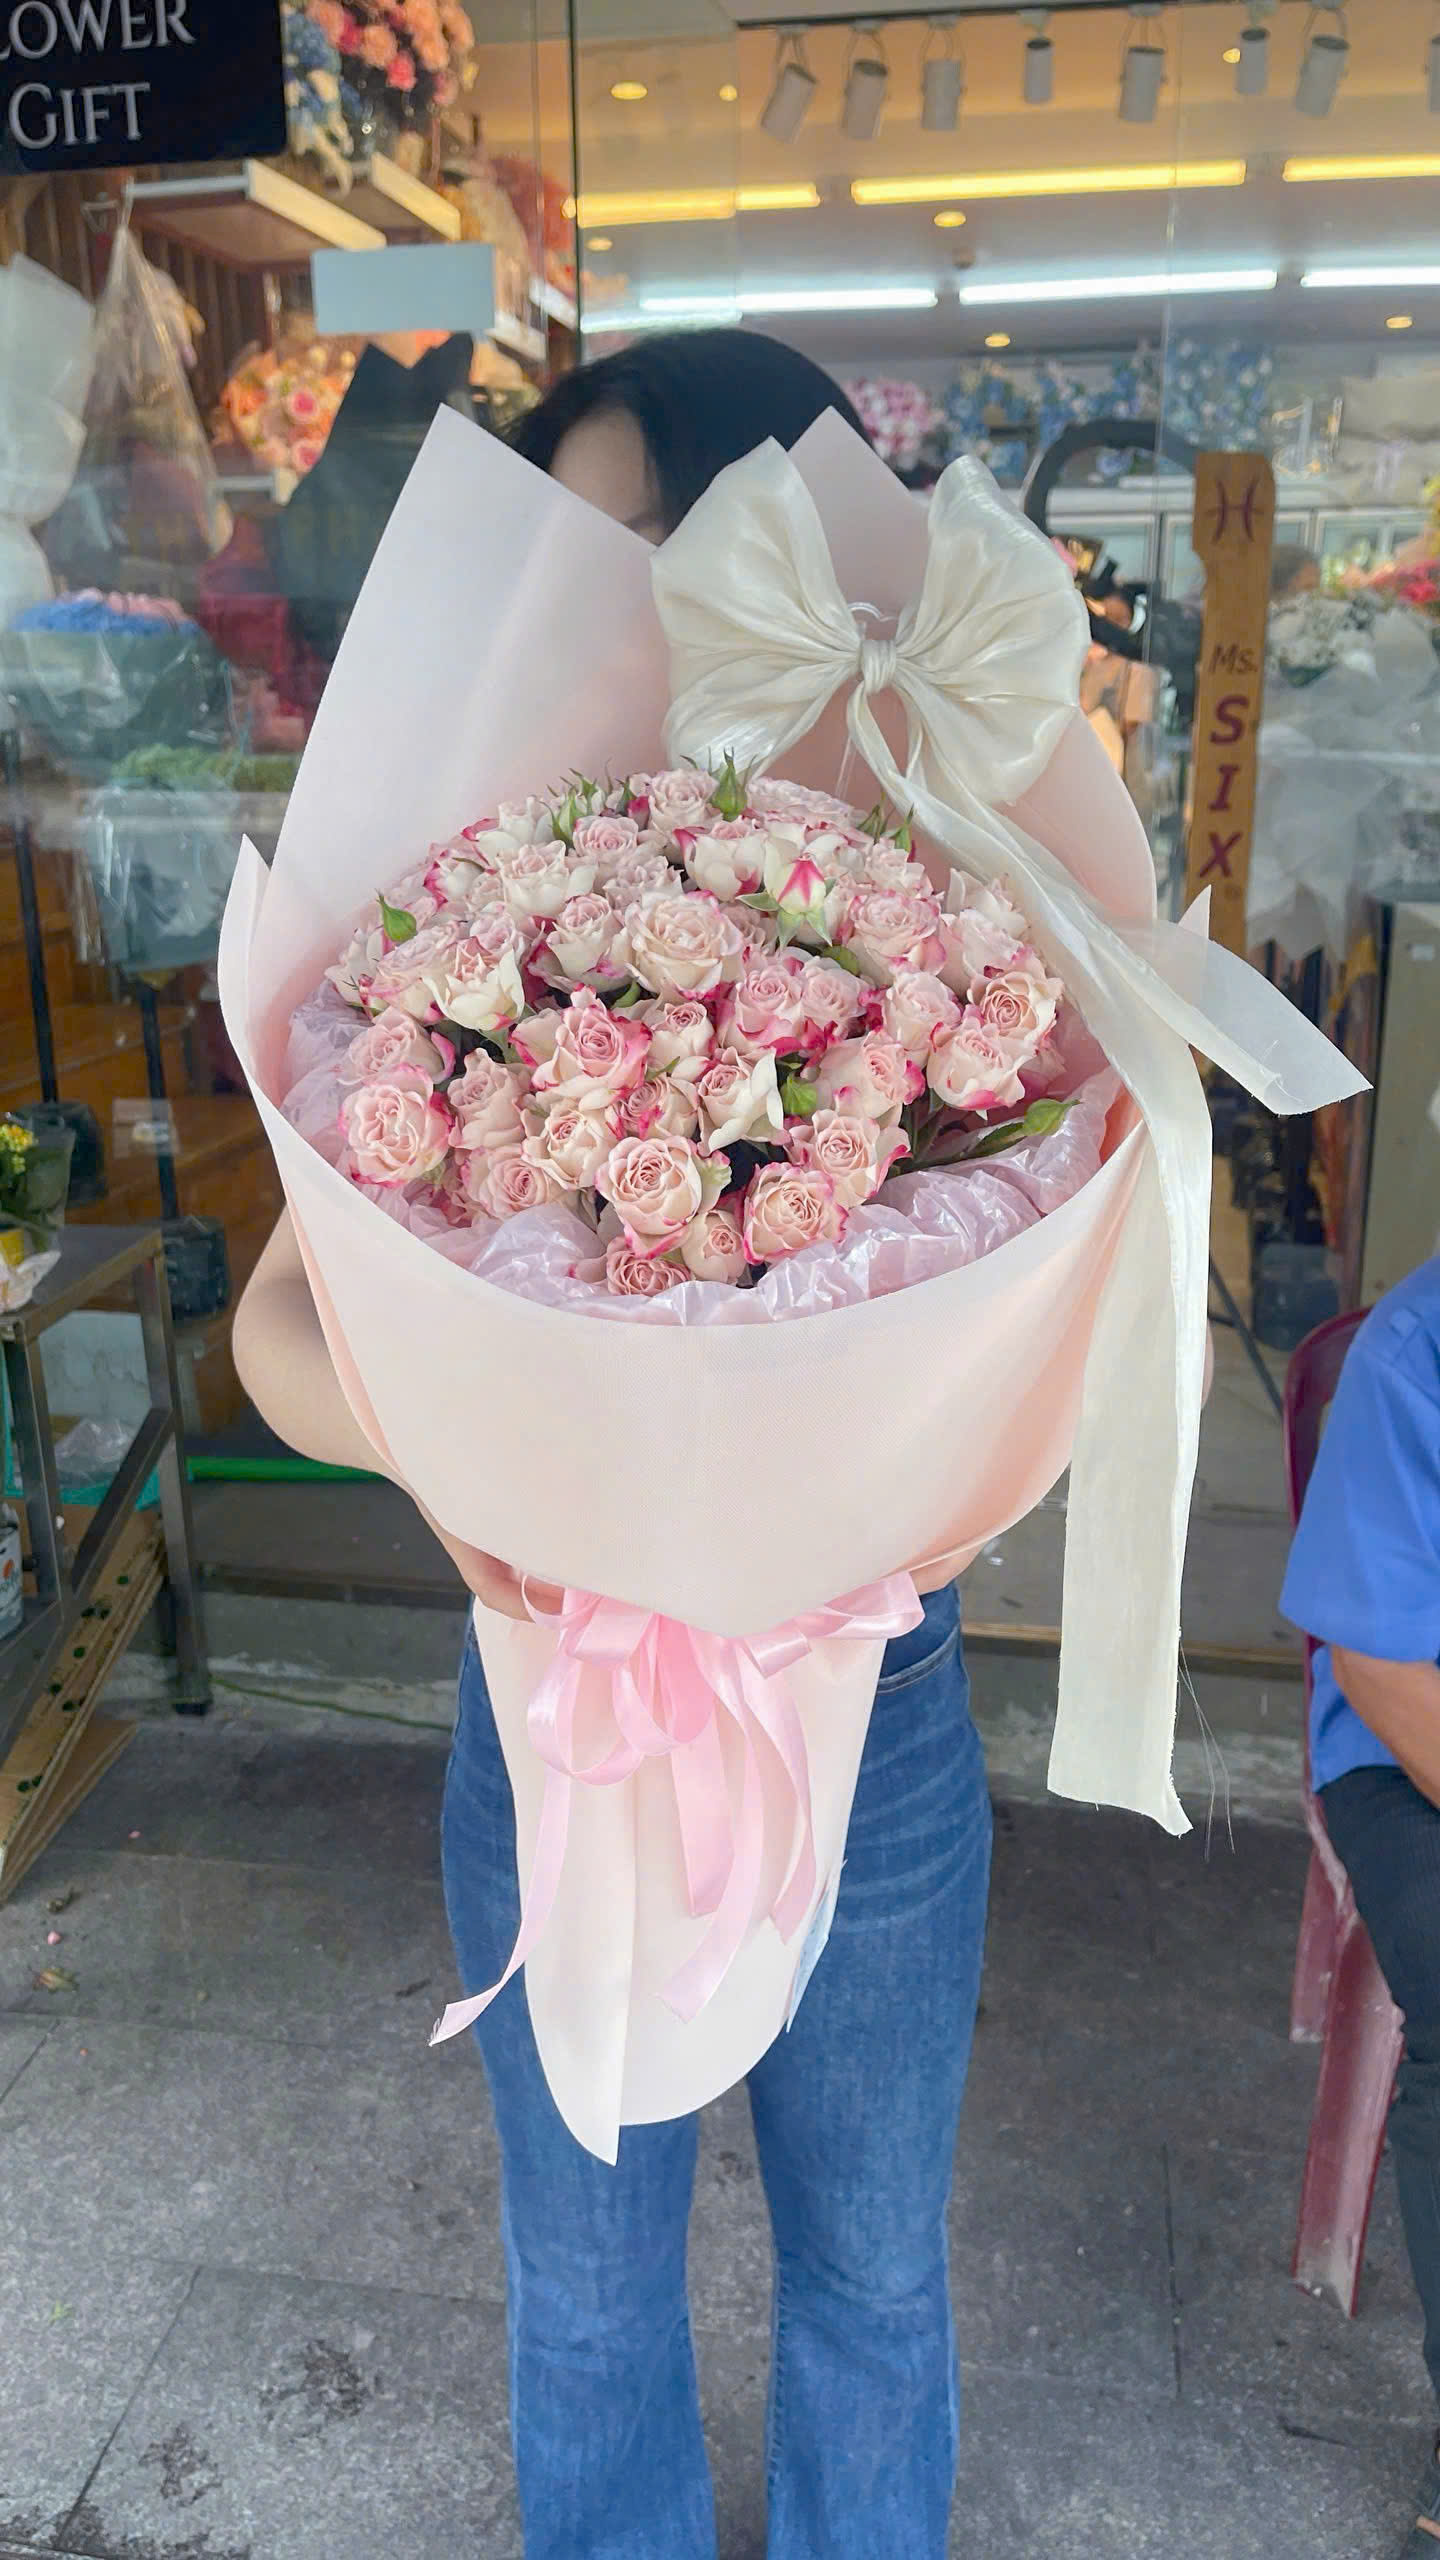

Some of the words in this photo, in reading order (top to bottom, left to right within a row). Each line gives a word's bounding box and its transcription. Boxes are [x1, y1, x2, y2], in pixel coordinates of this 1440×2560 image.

[0, 0, 196, 59] OWER
[8, 82, 150, 149] GIFT
[1198, 694, 1249, 879] SIX
